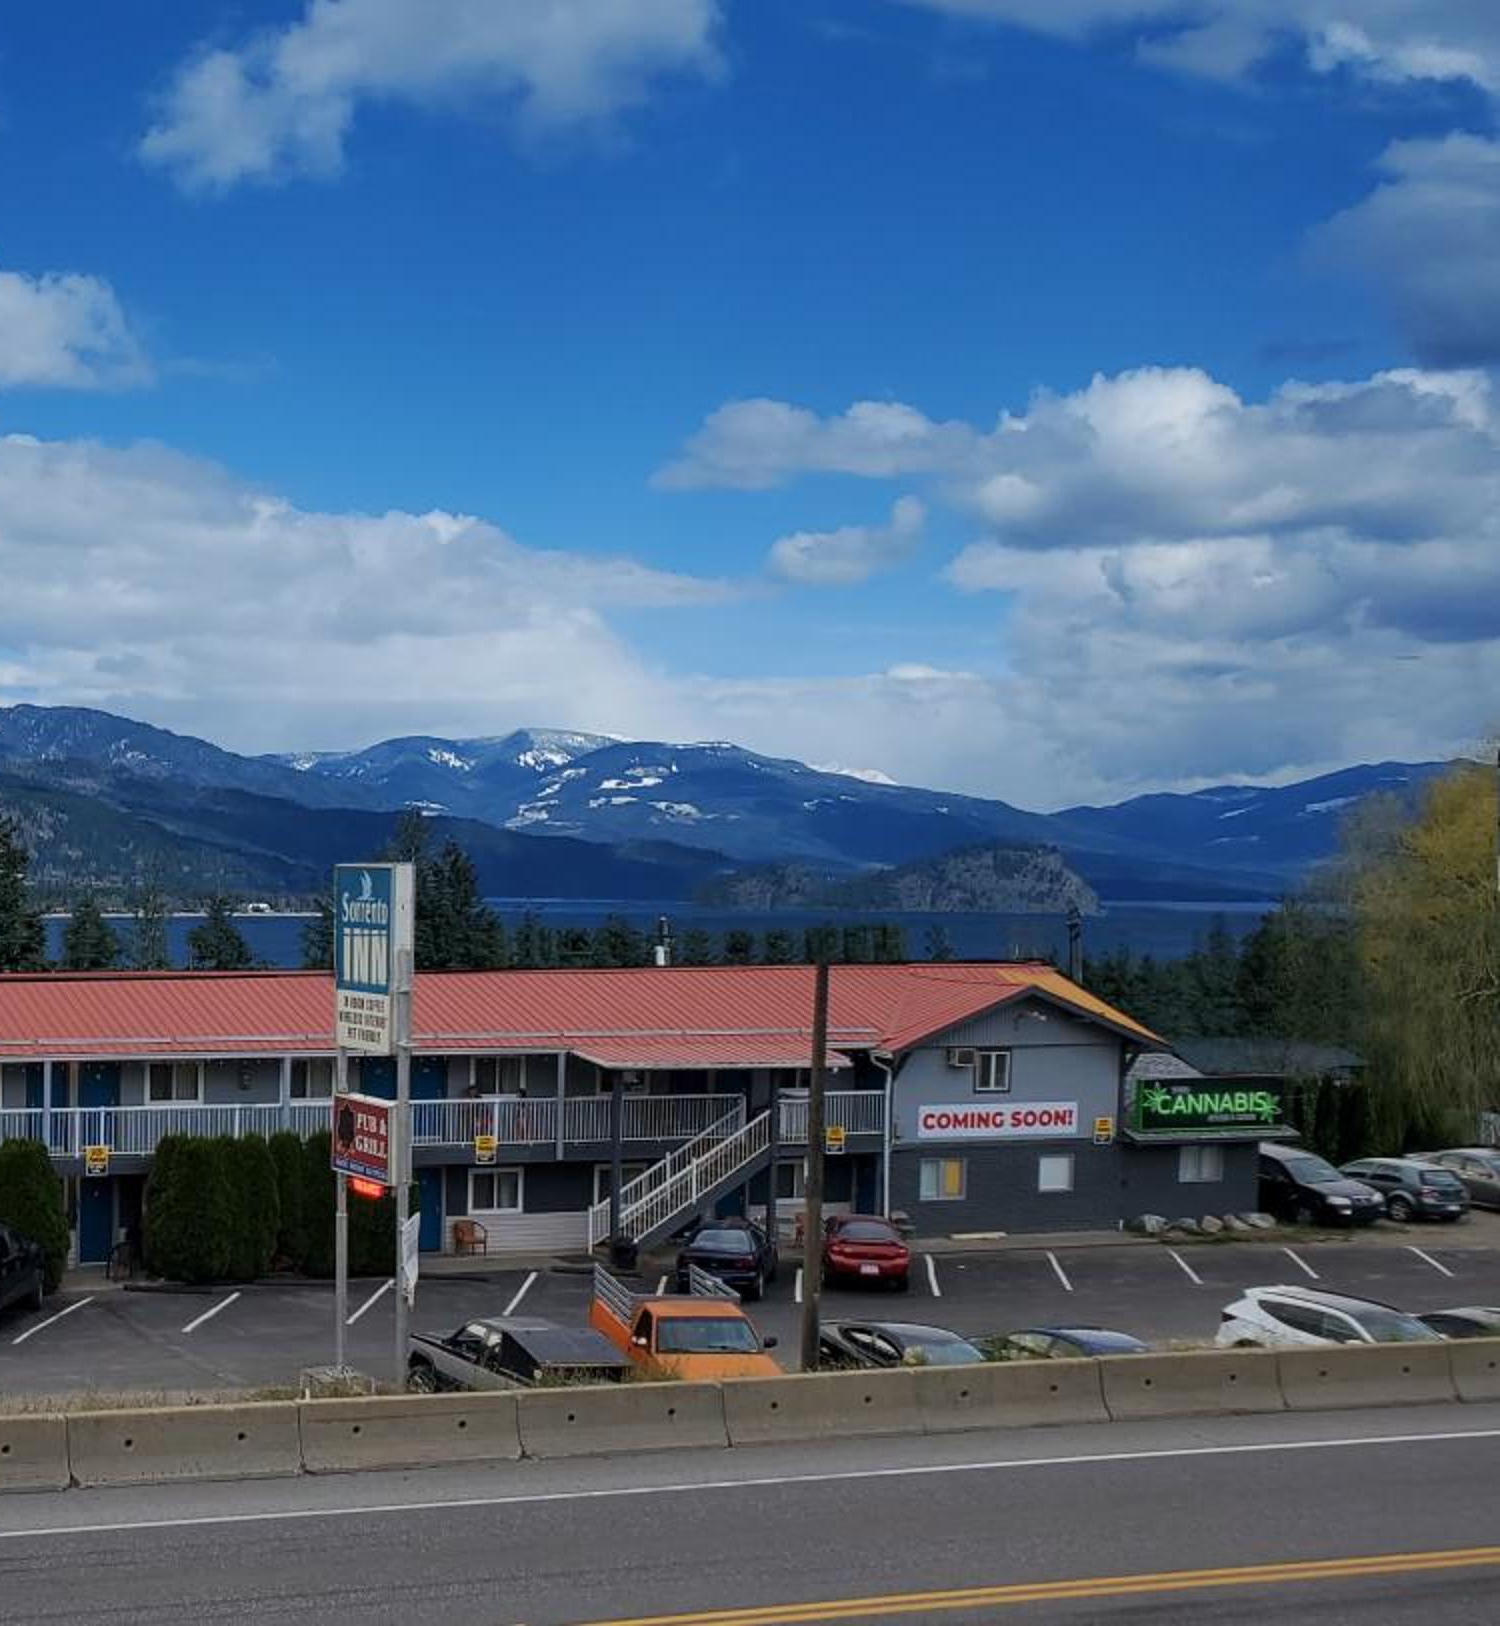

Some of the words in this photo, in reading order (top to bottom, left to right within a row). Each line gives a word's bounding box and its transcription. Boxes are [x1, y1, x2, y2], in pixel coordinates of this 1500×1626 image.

[342, 891, 388, 925] Sorrento
[343, 927, 388, 985] INN
[1156, 1091, 1268, 1115] CANNABIS
[357, 1113, 377, 1133] PUB
[923, 1112, 1005, 1130] COMING
[1010, 1109, 1073, 1127] SOON!
[355, 1135, 387, 1158] GRILL
